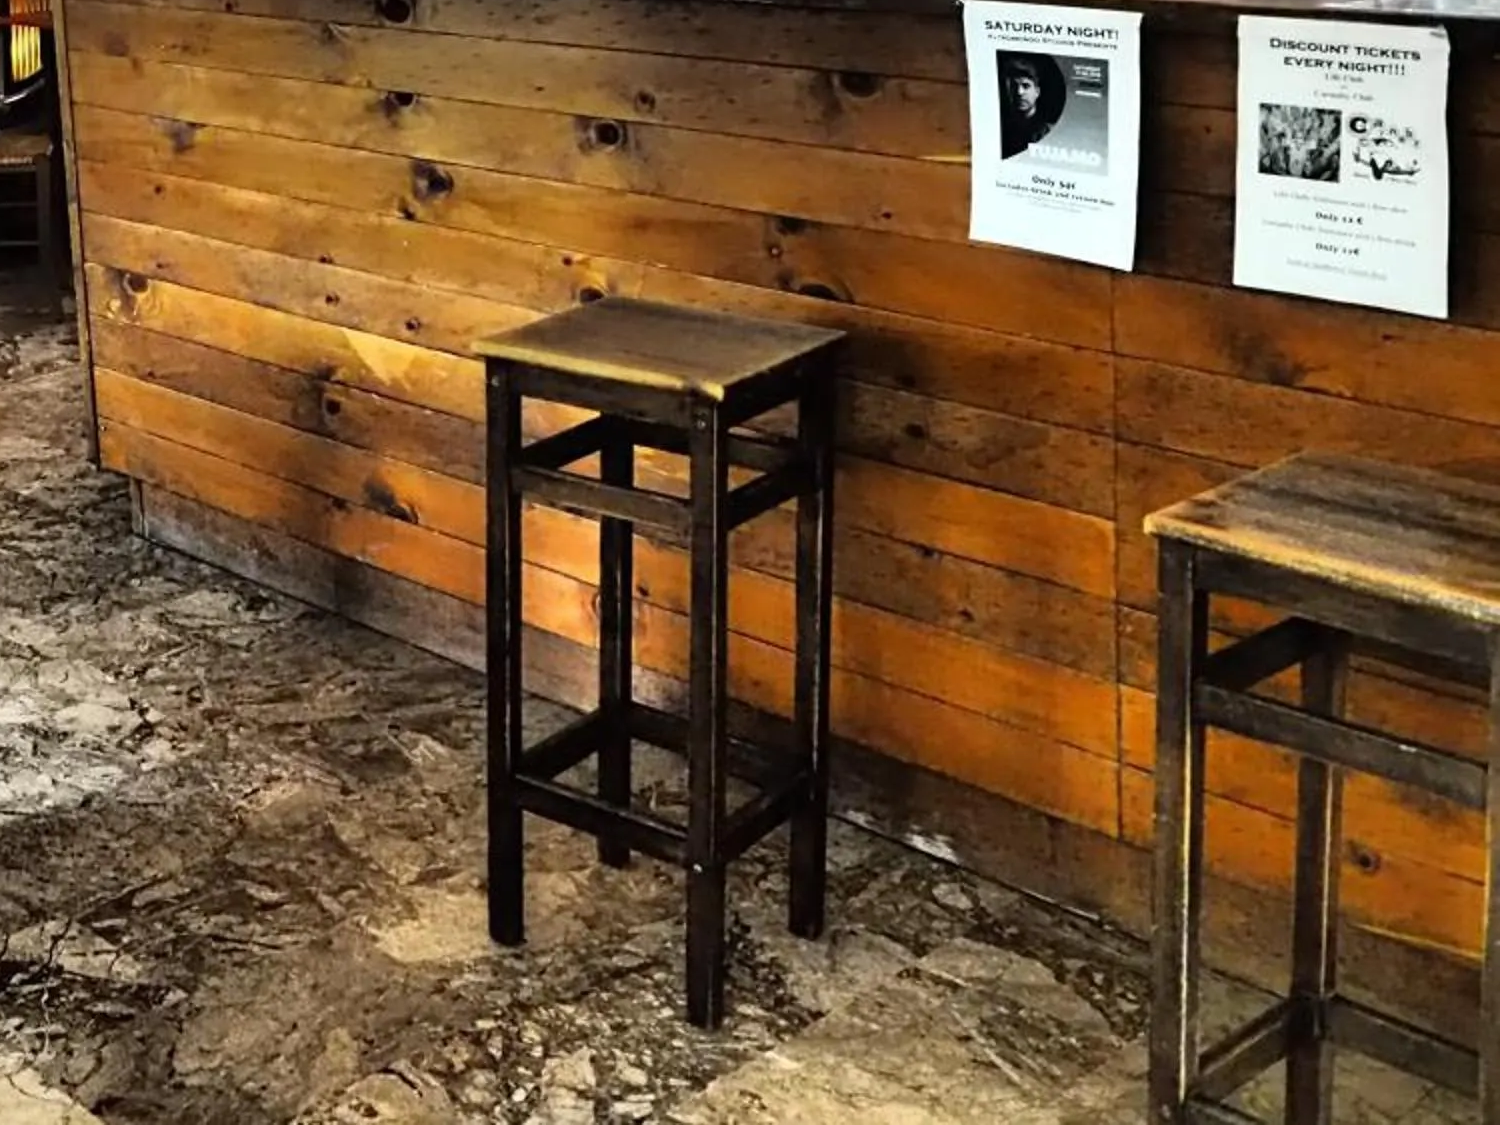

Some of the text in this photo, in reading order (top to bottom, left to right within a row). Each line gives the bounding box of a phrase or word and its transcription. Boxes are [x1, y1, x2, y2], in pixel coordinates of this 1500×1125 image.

[984, 20, 1119, 40] SATURDAY NIGHT!
[1355, 46, 1421, 61] TICKETS
[1283, 56, 1405, 75] EVERY NIGHT!!!
[1031, 175, 1056, 188] Only
